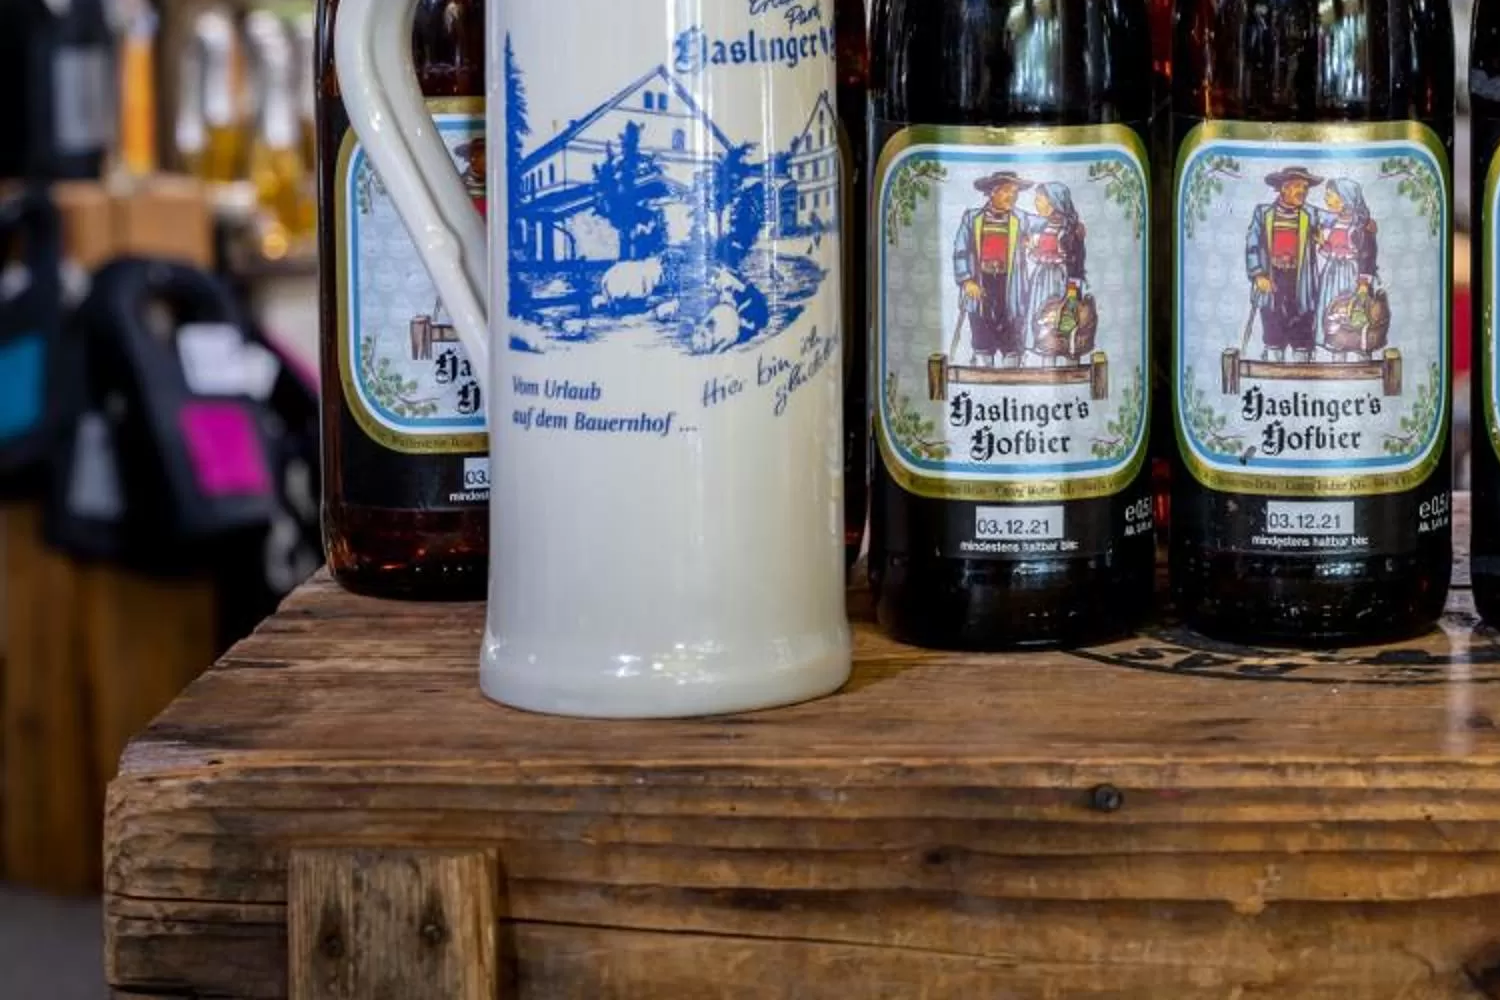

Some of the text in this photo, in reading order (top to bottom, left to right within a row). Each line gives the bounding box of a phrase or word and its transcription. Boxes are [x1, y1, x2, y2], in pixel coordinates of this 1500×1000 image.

[513, 376, 602, 401] Vom Urlaub
[1242, 385, 1381, 423] Haslinger's
[512, 407, 537, 430] auf
[536, 409, 568, 430] dem
[574, 411, 675, 437] Bauernhof
[950, 392, 1089, 427] Haslinger's
[970, 426, 1071, 461] Hofbier
[1261, 420, 1362, 456] Hofbier
[977, 519, 1050, 534] 03.12.21
[1269, 513, 1341, 529] 03.12.21
